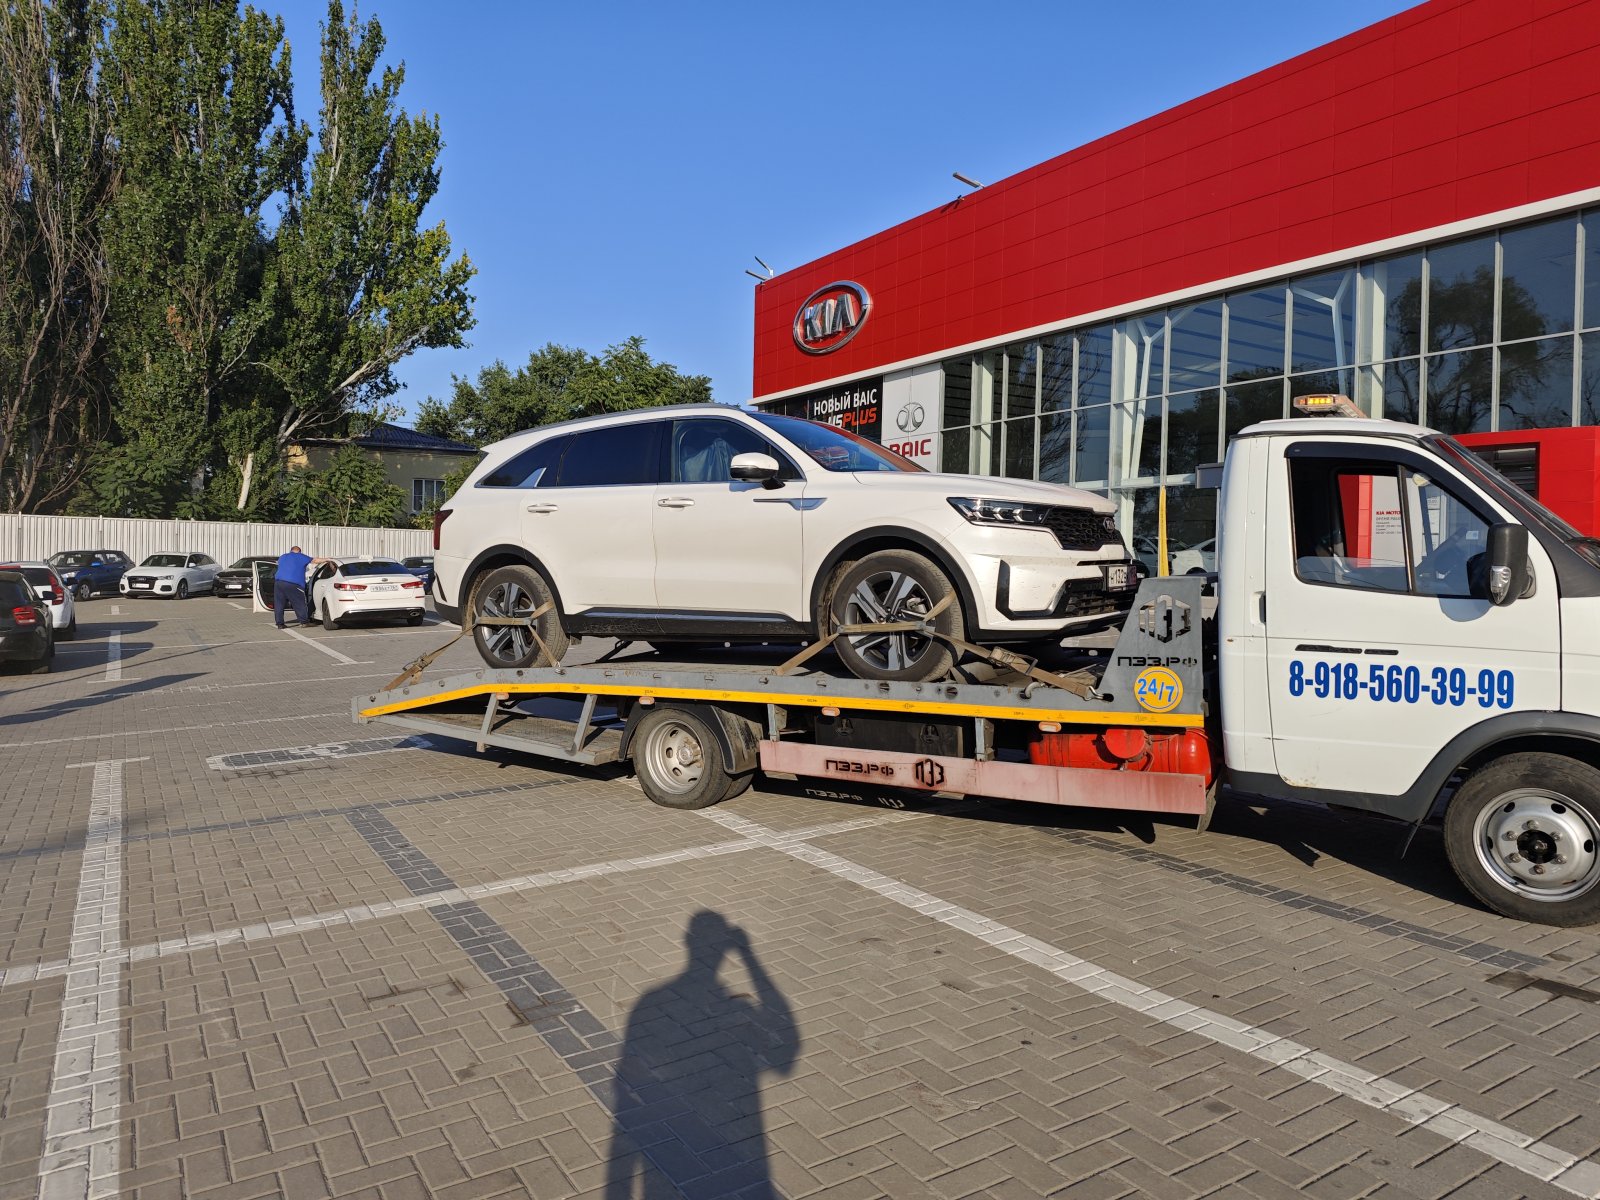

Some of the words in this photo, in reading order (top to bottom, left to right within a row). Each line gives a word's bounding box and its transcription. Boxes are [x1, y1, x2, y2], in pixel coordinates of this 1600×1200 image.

[804, 293, 856, 341] KIA
[814, 391, 851, 416] НОВЫЙ
[853, 388, 877, 408] BAIC
[1137, 678, 1175, 703] 24/7
[1289, 660, 1515, 710] 8-918-560-39-99
